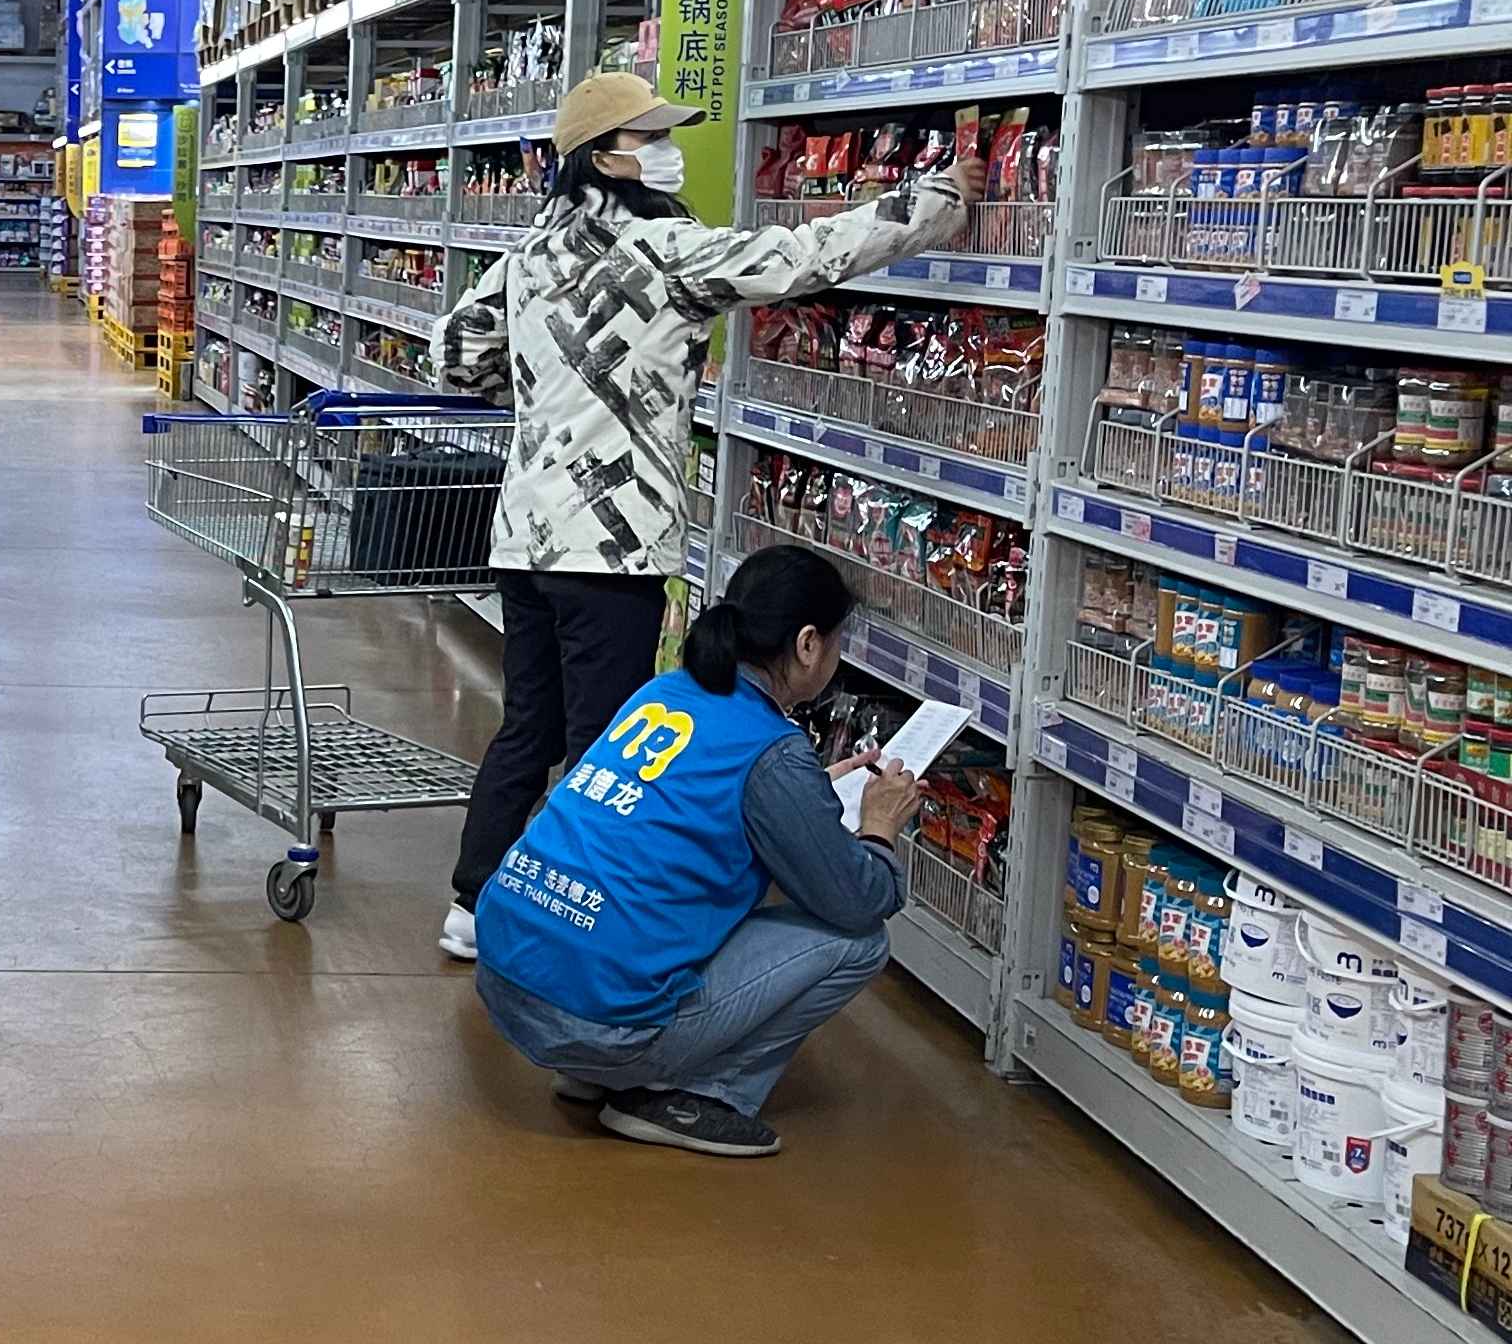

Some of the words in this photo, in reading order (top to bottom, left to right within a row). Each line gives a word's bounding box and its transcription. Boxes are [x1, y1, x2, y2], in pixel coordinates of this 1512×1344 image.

[712, 58, 725, 86] POT
[709, 92, 721, 121] HOT
[566, 763, 644, 816] 麦德龙
[523, 884, 551, 908] THAN
[550, 898, 596, 932] BETTER
[1436, 1207, 1471, 1252] 737
[1491, 1246, 1511, 1280] 12
